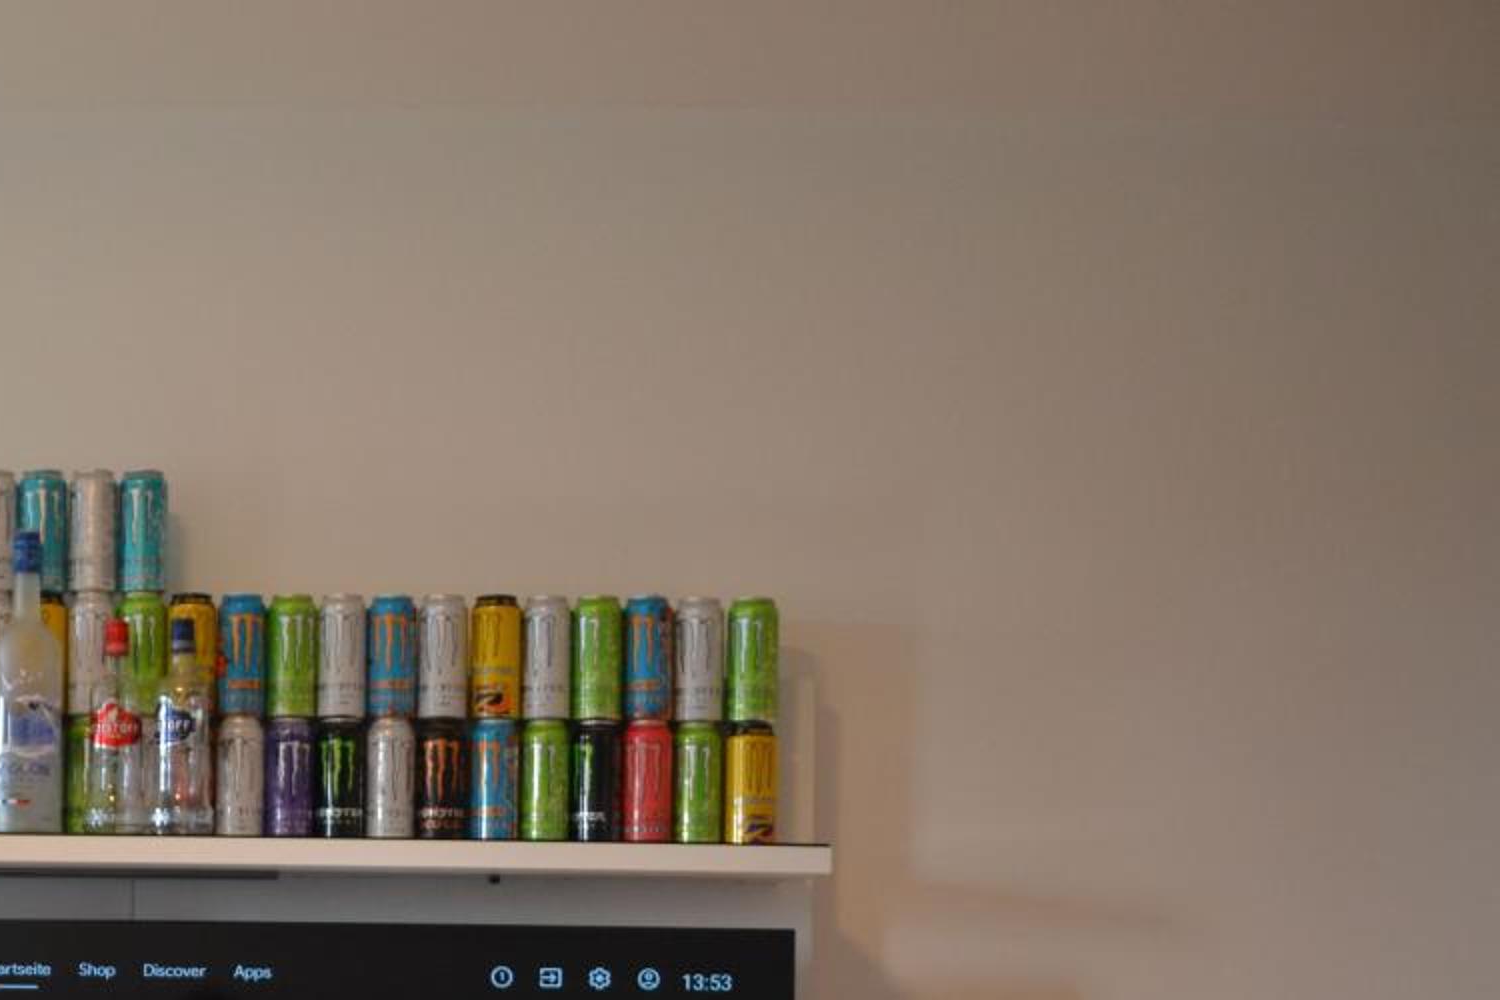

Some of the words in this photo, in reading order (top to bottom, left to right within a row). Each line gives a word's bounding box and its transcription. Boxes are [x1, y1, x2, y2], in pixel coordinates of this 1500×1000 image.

[78, 961, 117, 980] Shop
[143, 962, 207, 978] Discover
[233, 964, 273, 981] Apps
[682, 973, 732, 991] 13:53
